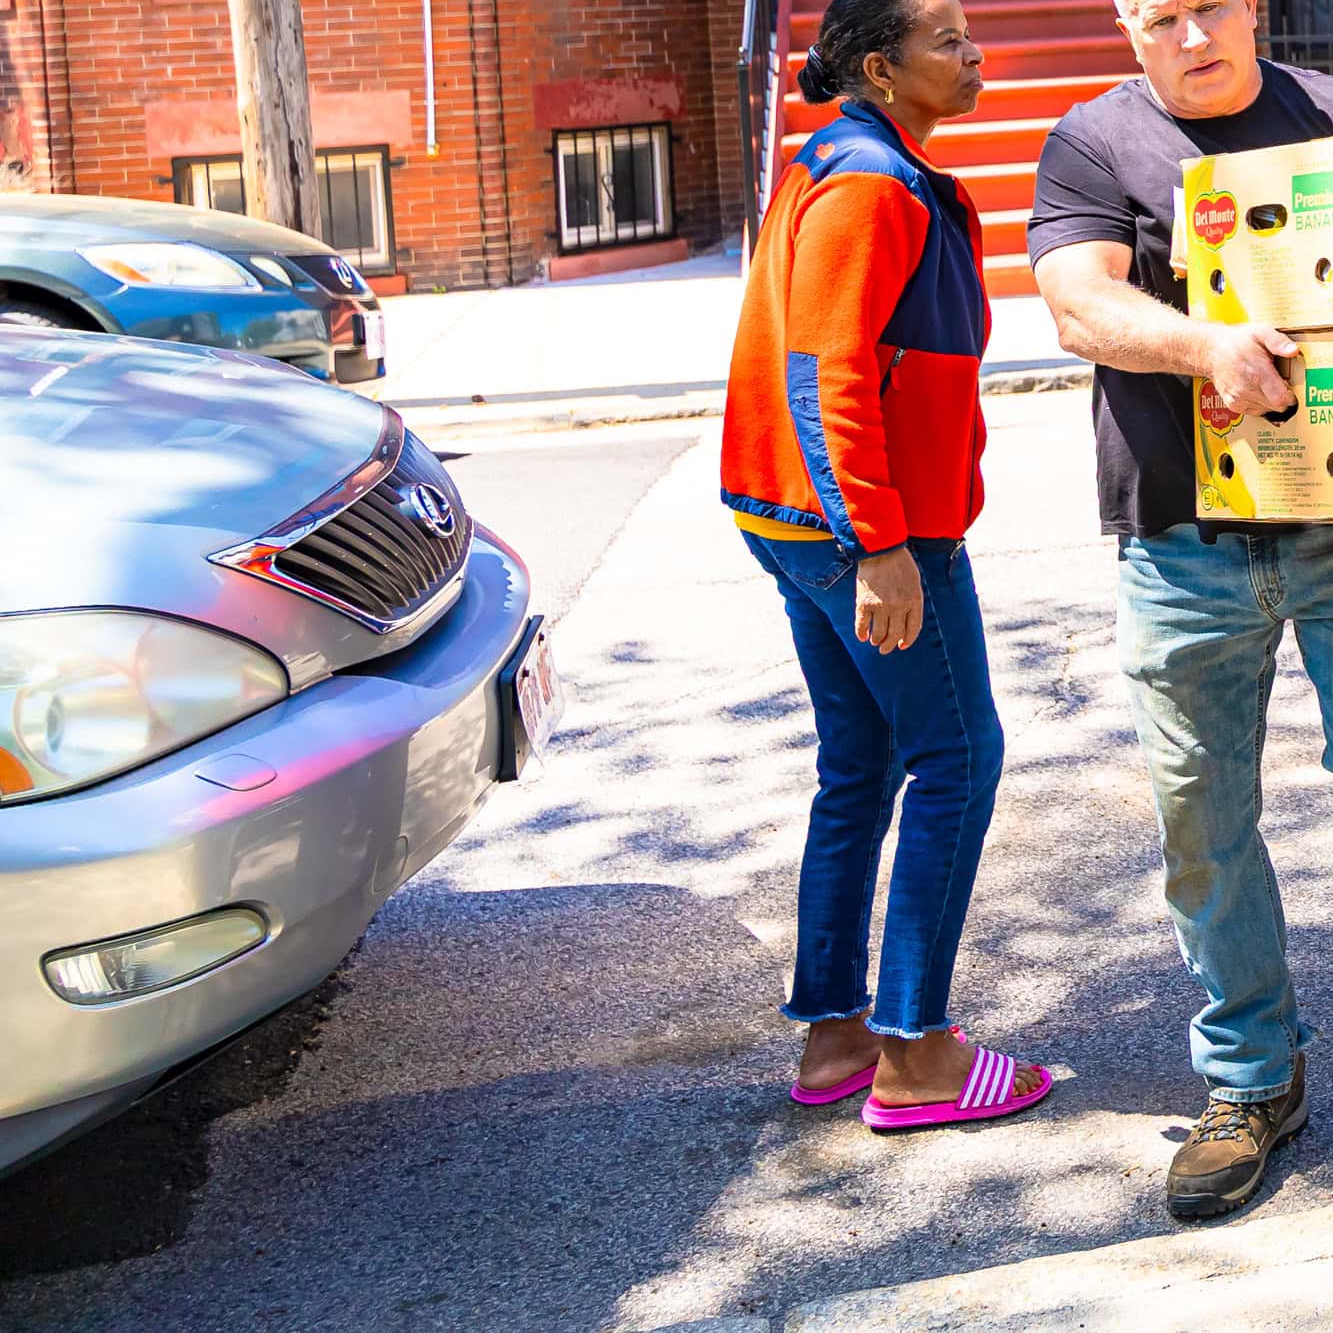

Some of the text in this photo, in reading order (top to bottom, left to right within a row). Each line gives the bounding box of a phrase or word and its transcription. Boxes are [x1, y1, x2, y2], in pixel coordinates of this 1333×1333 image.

[1195, 208, 1235, 227] Del Monte
[1201, 394, 1213, 409] Del
